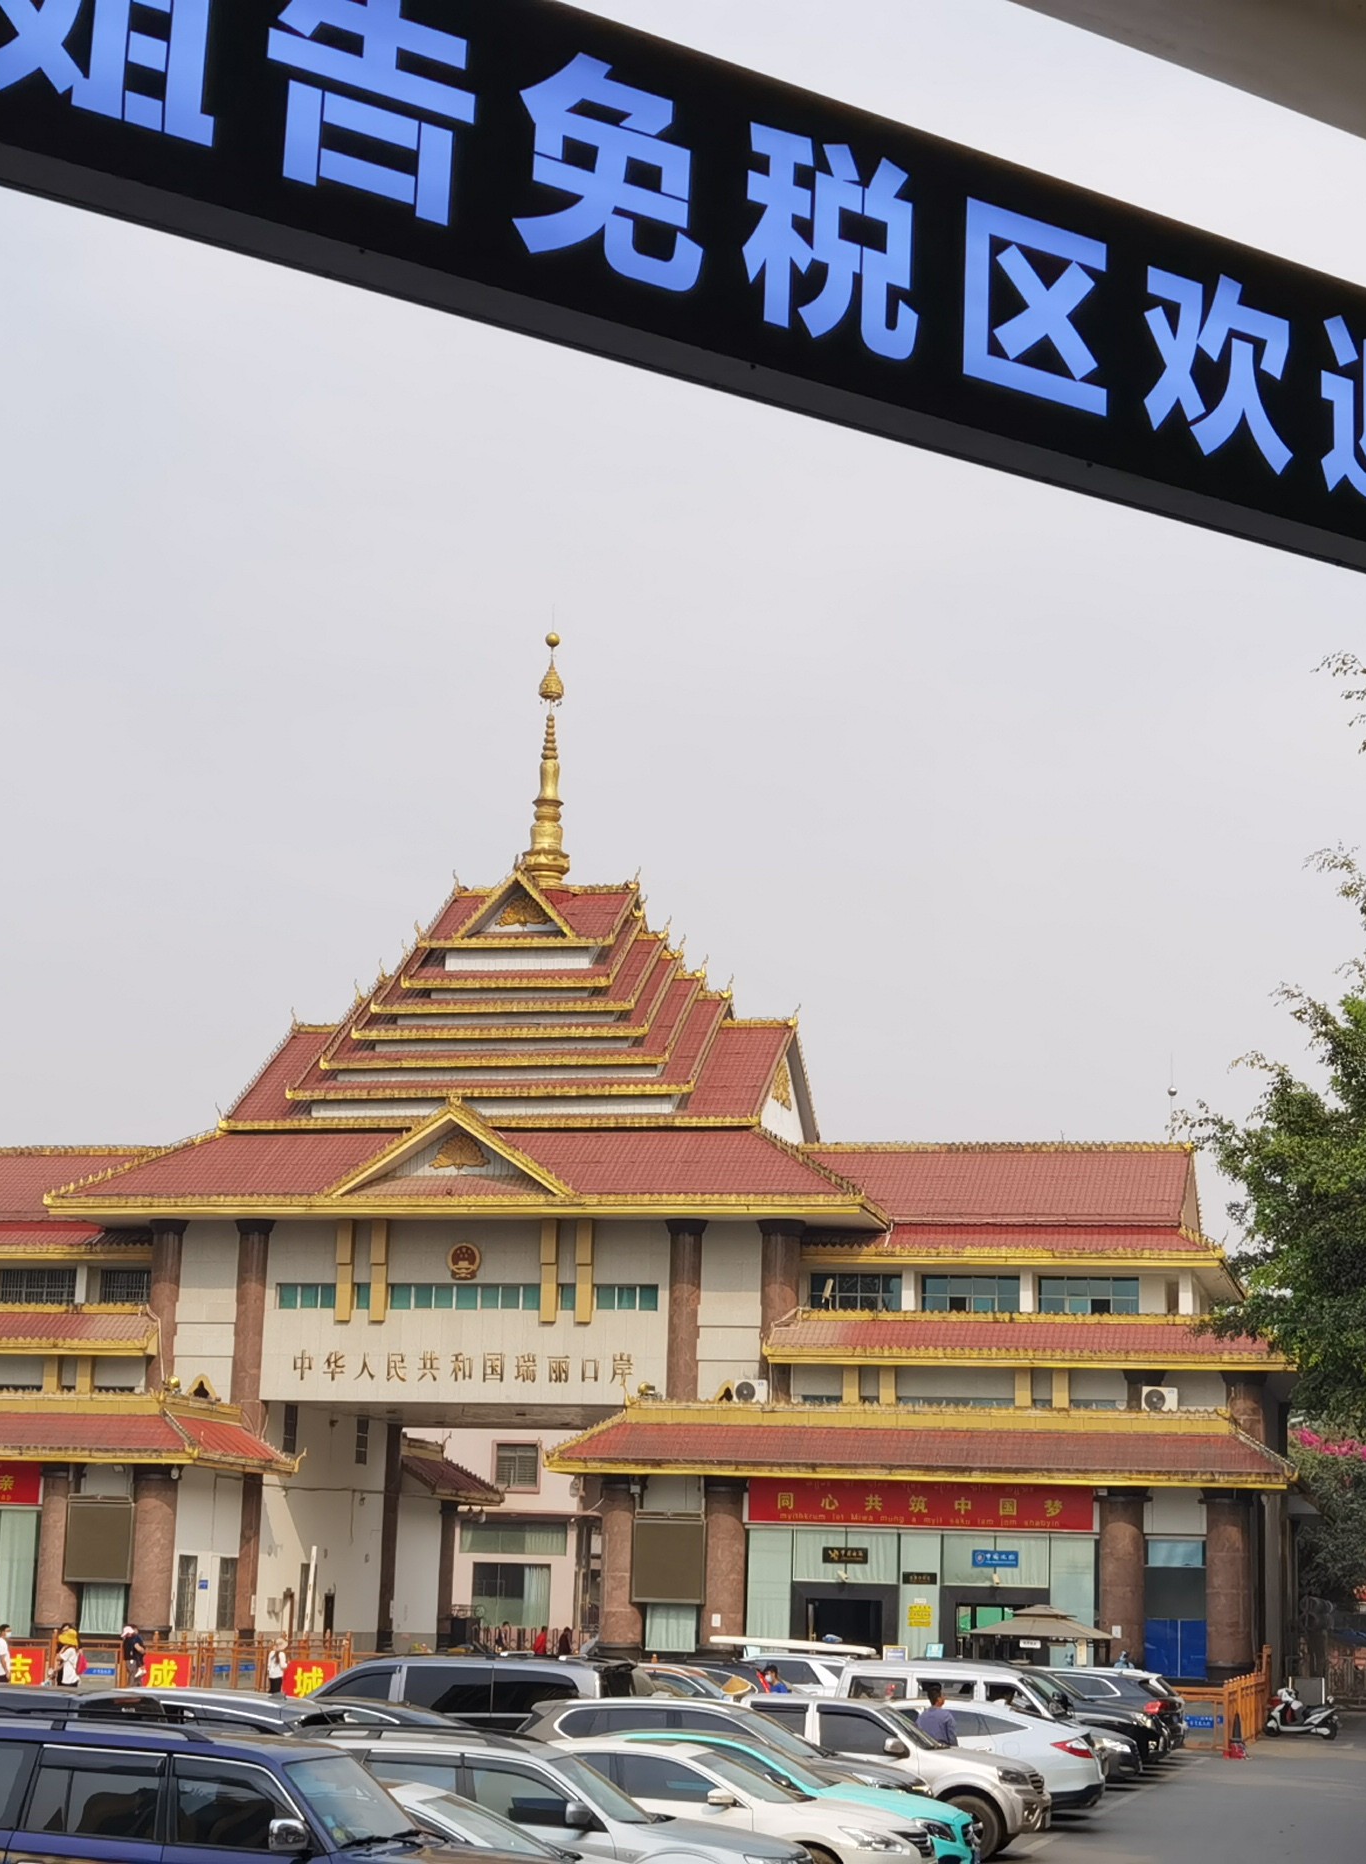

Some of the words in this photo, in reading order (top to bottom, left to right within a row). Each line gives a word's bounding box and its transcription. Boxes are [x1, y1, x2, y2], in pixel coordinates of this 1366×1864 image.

[292, 1349, 634, 1385] 中华人民共和国瑞丽口岸
[777, 1492, 1063, 1518] 同心共筑中国梦
[10, 1653, 33, 1685] 志
[146, 1658, 178, 1688] 成
[293, 1666, 324, 1698] 城
